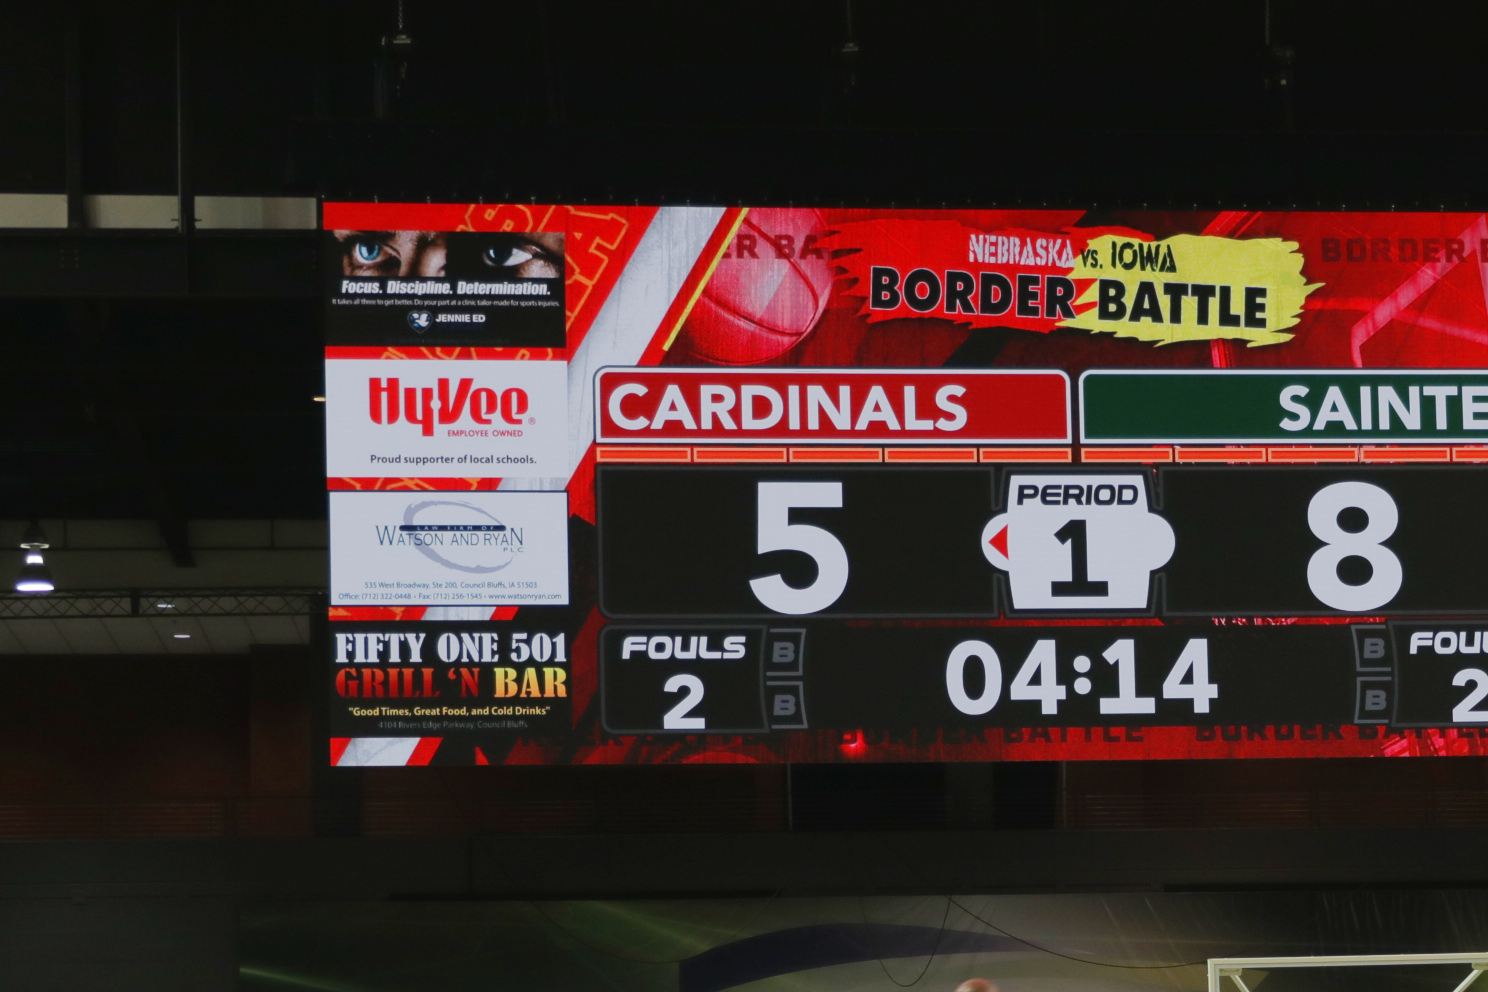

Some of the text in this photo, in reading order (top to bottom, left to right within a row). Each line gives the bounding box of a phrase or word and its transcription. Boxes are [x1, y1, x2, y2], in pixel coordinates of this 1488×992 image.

[969, 234, 1074, 268] NEBRASKA
[1111, 241, 1177, 273] IOWA
[1321, 237, 1467, 263] BORDER
[341, 280, 550, 295] Focus. Discipline. Determination.
[870, 266, 1268, 329] BORDER BATTLE
[385, 299, 394, 307] get
[435, 314, 485, 322] JENNIE ED
[608, 383, 967, 431] CARDINALS
[370, 455, 537, 465] Proud supporter of local schools.
[1016, 483, 1138, 506] PERIOD
[450, 533, 480, 546] AND
[483, 527, 524, 546] RYAN
[1306, 481, 1403, 612] 8
[748, 481, 849, 615] 5
[1050, 519, 1108, 598] 1
[396, 582, 431, 590] Broadway,
[444, 582, 458, 590] 200,
[486, 582, 507, 590] Bluffs,
[361, 593, 379, 601] (712)
[433, 593, 450, 601] (712)
[488, 593, 562, 602] www.watsonryan.com
[335, 632, 567, 663] FIFTY ONE 501
[621, 635, 746, 660] FOULS
[772, 642, 795, 663] B
[1363, 638, 1386, 658] B
[335, 667, 441, 698] GRILL
[494, 667, 567, 698] BAR
[945, 638, 1218, 716] 04:14
[663, 673, 706, 730] 2
[773, 695, 796, 716] B
[1364, 690, 1387, 710] B
[349, 706, 551, 717] "Good Times, Great Food, and Cold Drinks"
[378, 721, 397, 729] 4104
[422, 721, 442, 730] Edge
[442, 721, 476, 730] Parkway,
[477, 720, 506, 728] Council
[507, 720, 528, 728] Bluffs
